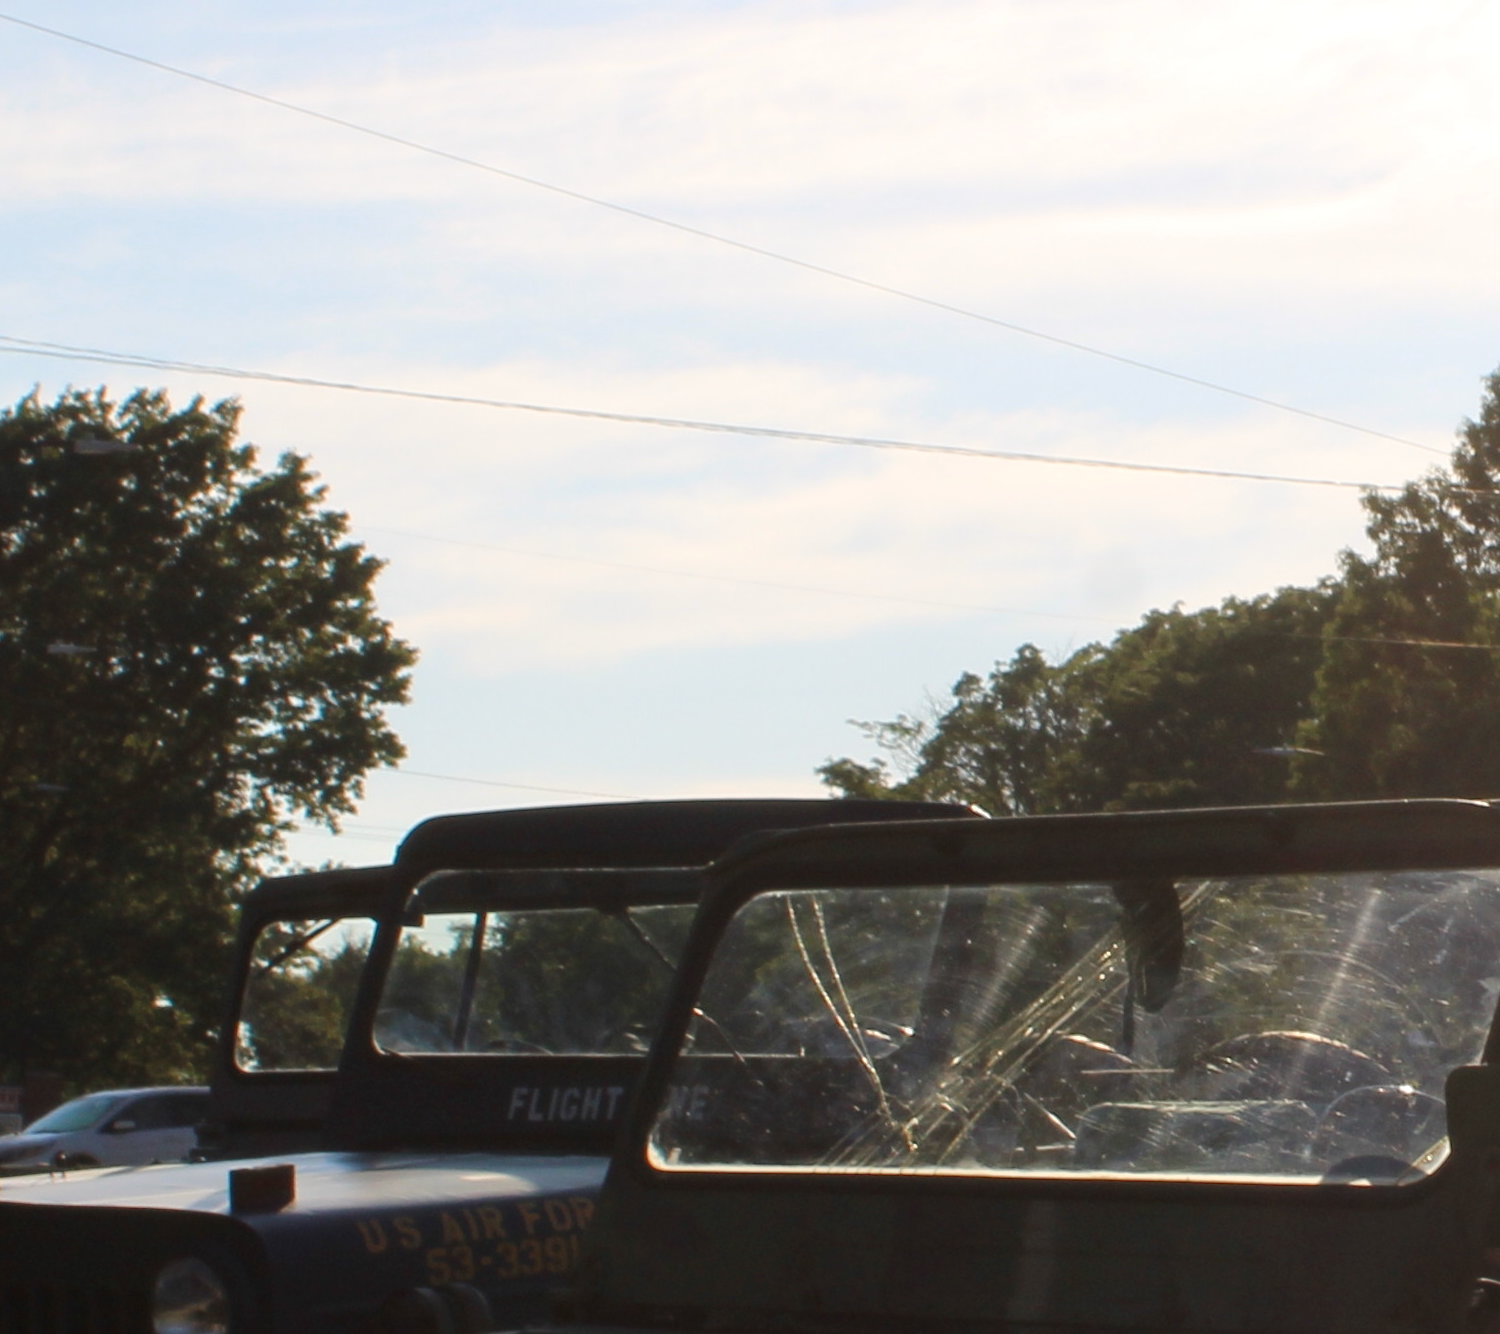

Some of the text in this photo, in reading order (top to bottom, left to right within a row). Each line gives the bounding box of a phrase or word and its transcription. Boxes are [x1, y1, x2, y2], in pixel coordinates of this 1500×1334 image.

[507, 1086, 625, 1121] FLIGHT
[441, 1206, 506, 1243] AIR
[516, 1197, 597, 1234] FOR
